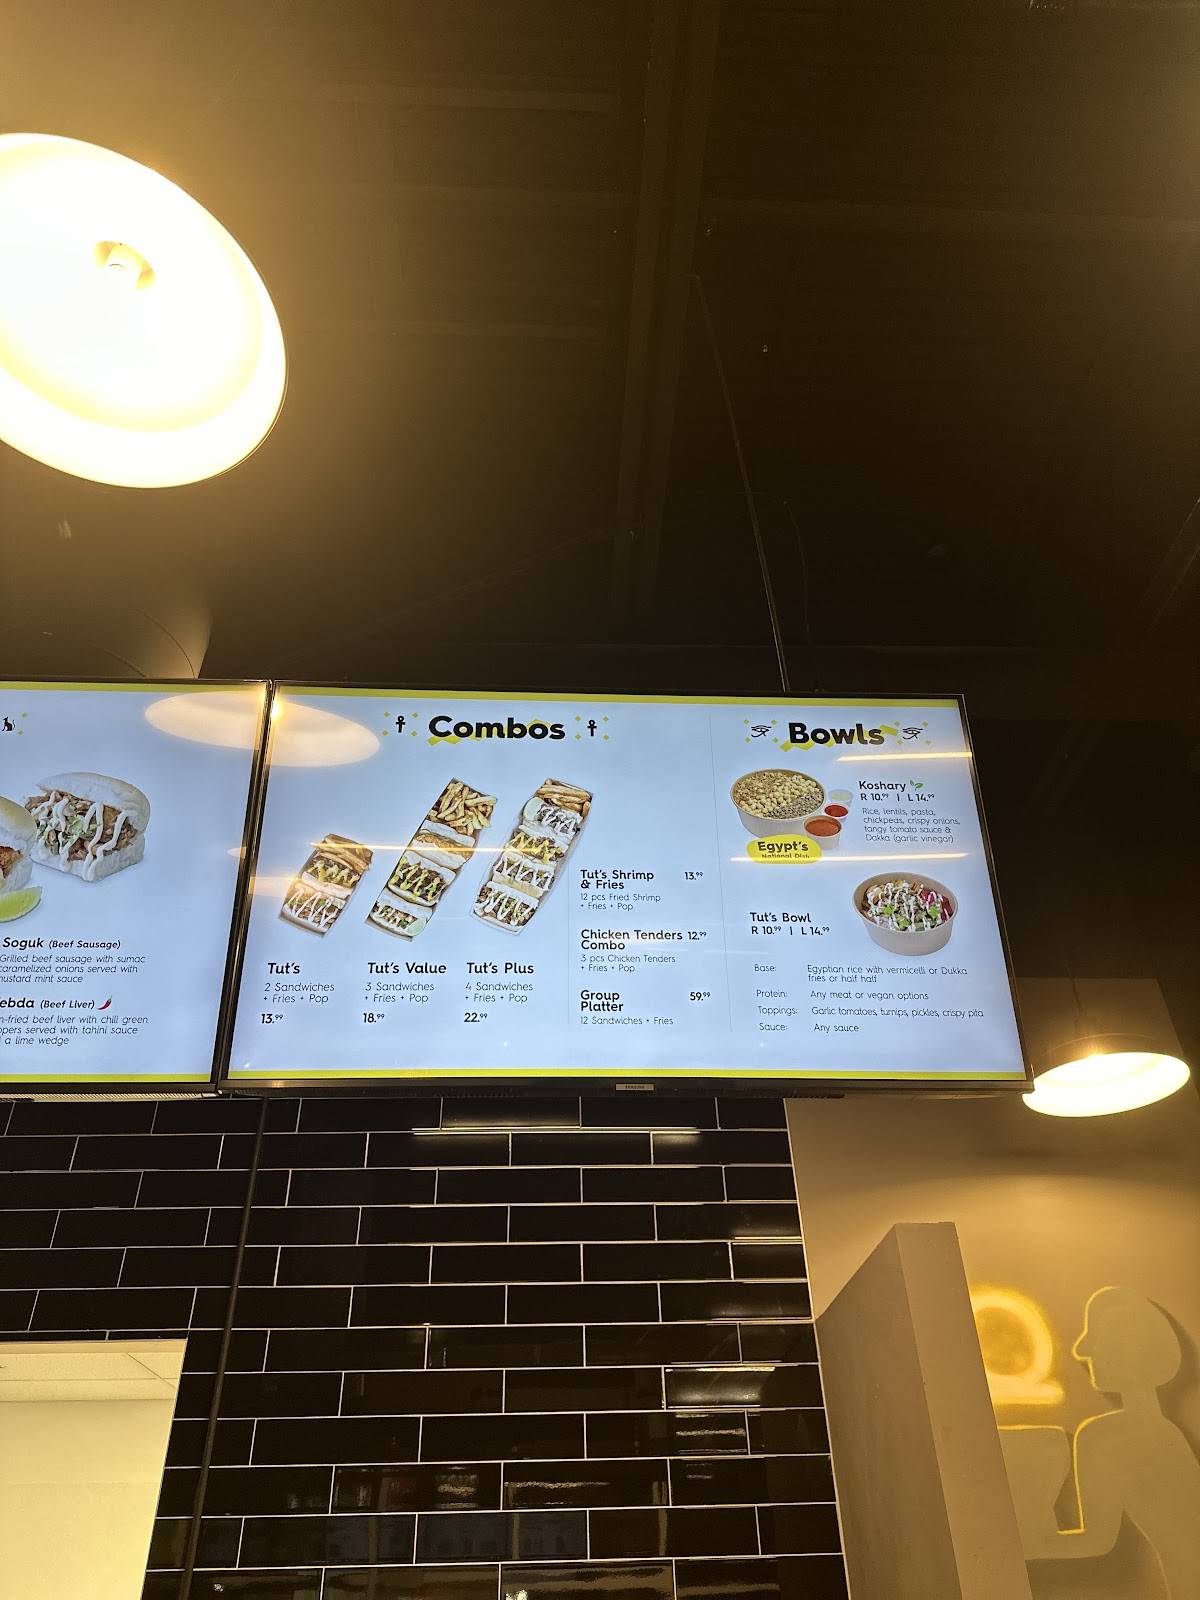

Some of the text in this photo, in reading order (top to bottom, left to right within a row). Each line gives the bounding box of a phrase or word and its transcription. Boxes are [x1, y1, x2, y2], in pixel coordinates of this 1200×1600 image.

[428, 715, 566, 740] Combos
[788, 722, 885, 745] Bowls
[859, 781, 906, 792] Koshary
[860, 793, 867, 801] R
[871, 793, 889, 801] 10.99
[915, 793, 935, 802] 14.99
[883, 808, 908, 816] lentils,
[907, 818, 930, 826] crispy
[864, 826, 887, 834] tangy
[893, 834, 918, 843] (garlic
[920, 835, 954, 843] vinegar)
[758, 841, 809, 853] Egypt's
[580, 869, 654, 881] Tut's Shrimp
[685, 871, 704, 880] 13.99
[580, 880, 625, 890] & Fries
[581, 893, 588, 901] 12
[609, 893, 630, 901] Fried
[632, 893, 661, 903] Shrimp
[588, 902, 607, 910] Fries
[617, 902, 634, 912] Pop
[750, 912, 811, 923] Tut's Bowl
[581, 929, 683, 940] Chicken Tenders
[688, 931, 707, 940] 12.99
[751, 926, 759, 934] R
[762, 926, 782, 935] 10.99
[801, 926, 807, 935] L
[810, 927, 830, 936] 14.99
[2, 937, 121, 950] Soguk (Beef Sausage)
[581, 940, 626, 950] Combo
[0, 954, 28, 963] Grilled
[32, 954, 52, 963] beef
[55, 956, 92, 965] sausage
[96, 955, 114, 963] with
[580, 954, 676, 964] 3 pcs Chicken Tenders
[55, 965, 84, 973] onions
[87, 965, 116, 973] served
[120, 965, 138, 973] with
[268, 962, 301, 974] Tut's
[368, 962, 447, 974] Tut's Value
[467, 962, 534, 974] Tut's Plus
[588, 964, 608, 972] Fries
[618, 964, 636, 973] Pop
[754, 964, 777, 972] Base:
[807, 965, 844, 974] Egyptian
[847, 965, 863, 973] rice
[866, 966, 884, 974] with
[887, 966, 926, 975] vermicelli
[941, 967, 968, 975] Dukka
[34, 975, 54, 983] mint
[808, 974, 826, 982] fries
[842, 975, 858, 983] half
[860, 975, 877, 983] half
[264, 982, 335, 992] 2 Sandwiches
[365, 982, 435, 992] 3 Sandwiches
[465, 981, 533, 992] 4 Sandwiches
[272, 994, 296, 1003] Fries
[309, 994, 329, 1004] Pop
[373, 993, 396, 1003] Fries
[409, 993, 429, 1004] Pop
[474, 993, 496, 1003] Fries
[509, 993, 528, 1004] Pop
[581, 989, 620, 1001] Group
[690, 991, 711, 1001] 59.99
[756, 989, 787, 998] Protein:
[810, 990, 827, 1000] Any
[830, 991, 852, 999] meat
[867, 993, 894, 1001] vegan
[897, 992, 929, 1001] options
[40, 1000, 66, 1009] (Beef
[69, 1000, 95, 1009] Liver)
[581, 1001, 624, 1012] Platter
[758, 1006, 984, 1018] Toppings: Garlic tomatoes, turnips, pickles, crispy pita
[32, 1015, 54, 1023] beef
[122, 1017, 148, 1025] green
[261, 1013, 283, 1024] 13.99
[363, 1013, 385, 1023] 18.99
[464, 1012, 488, 1023] 22.99
[580, 1016, 588, 1025] 12
[591, 1016, 643, 1025] Sandwiches
[653, 1016, 674, 1025] Fries
[25, 1026, 56, 1034] served
[82, 1026, 107, 1034] tahini
[759, 1023, 788, 1031] Sauce:
[814, 1023, 831, 1033] Any
[15, 1037, 34, 1045] lime
[38, 1037, 69, 1047] wedge
